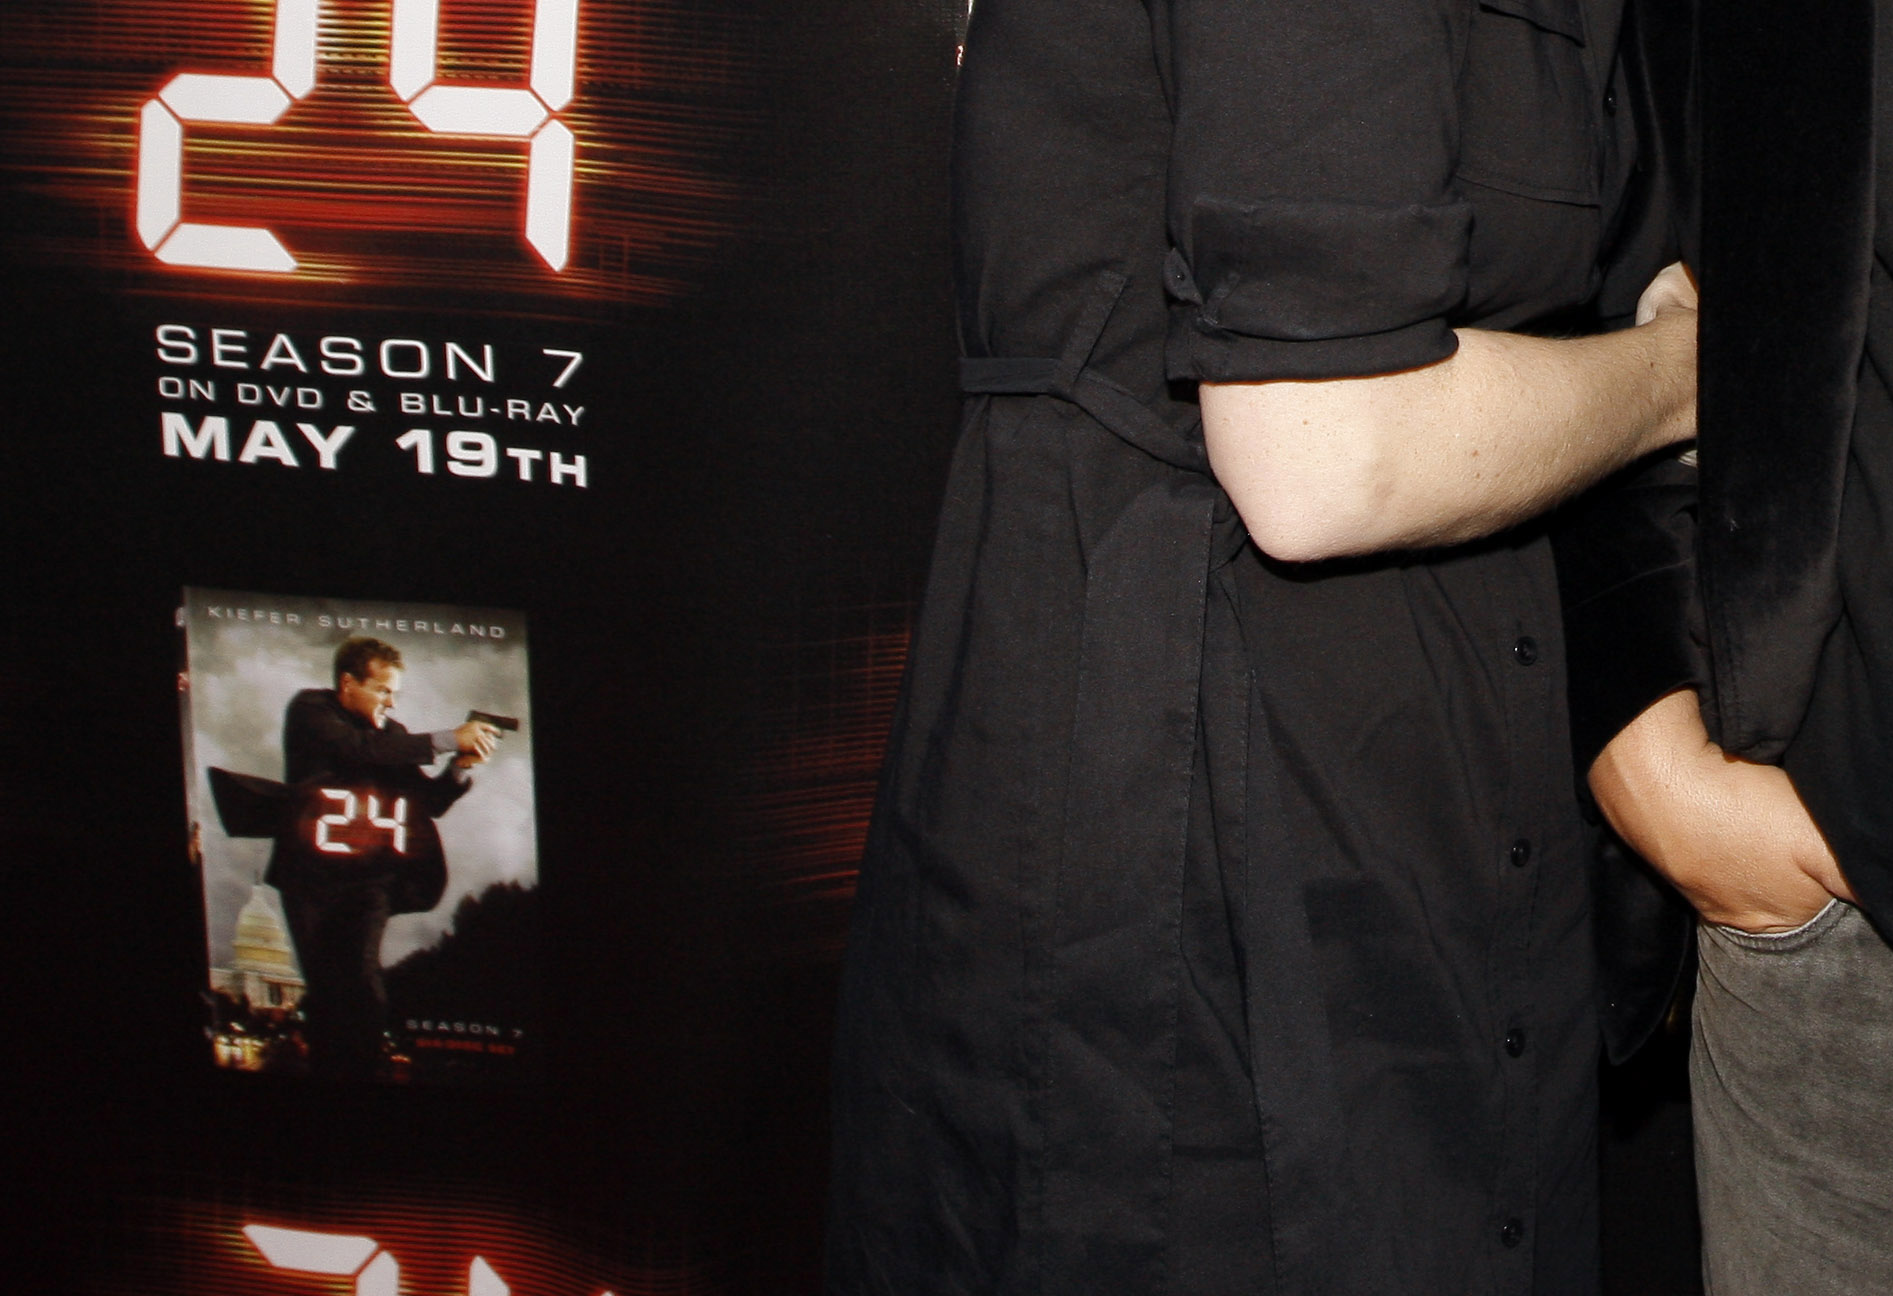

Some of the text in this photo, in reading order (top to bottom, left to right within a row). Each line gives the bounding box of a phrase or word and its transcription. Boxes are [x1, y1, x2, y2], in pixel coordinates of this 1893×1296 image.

[156, 324, 583, 388] SEASON 7
[158, 376, 585, 426] ON DVD & BLU-RAY
[161, 411, 587, 488] MAY 19TH
[207, 606, 506, 639] KIEFER SUTHERLAND
[315, 788, 407, 853] 24
